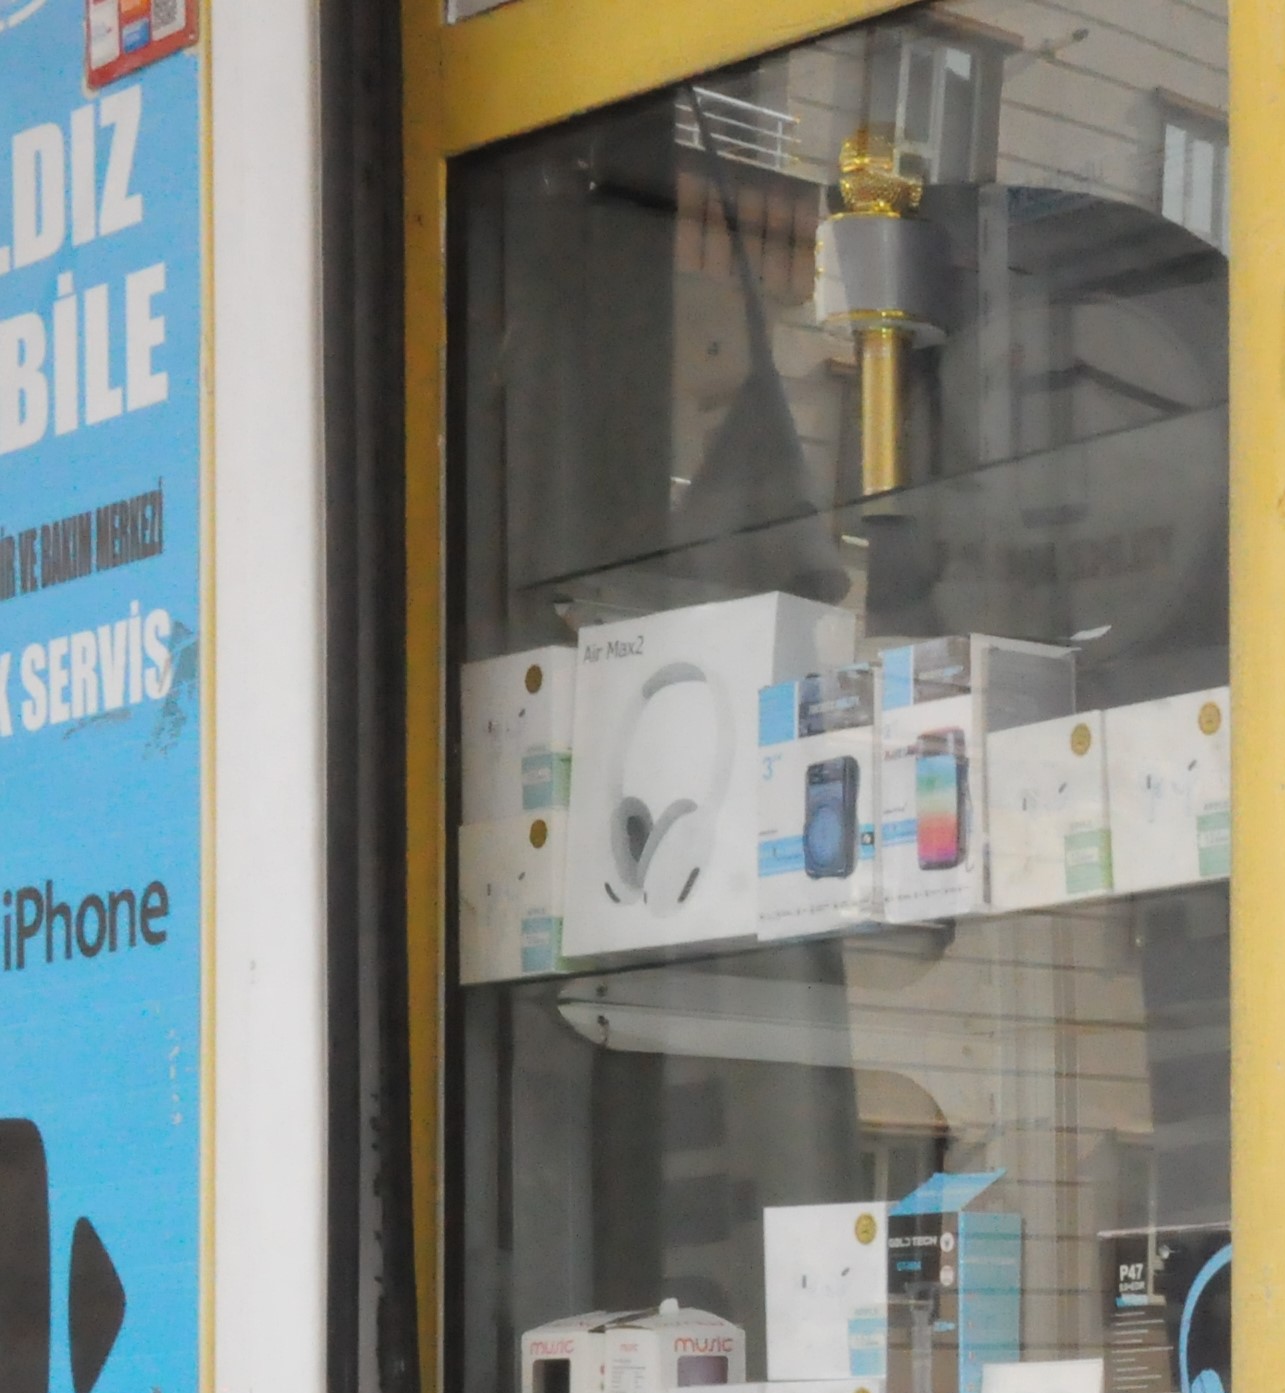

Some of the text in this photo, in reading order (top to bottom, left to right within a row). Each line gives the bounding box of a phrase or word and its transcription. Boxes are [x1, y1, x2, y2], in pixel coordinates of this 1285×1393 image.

[0, 85, 143, 276] DIZ
[21, 599, 172, 732] SERVİS
[3, 879, 170, 971] iPhone
[1119, 1263, 1144, 1281] P47
[530, 1338, 574, 1355] music
[674, 1336, 733, 1353] music
